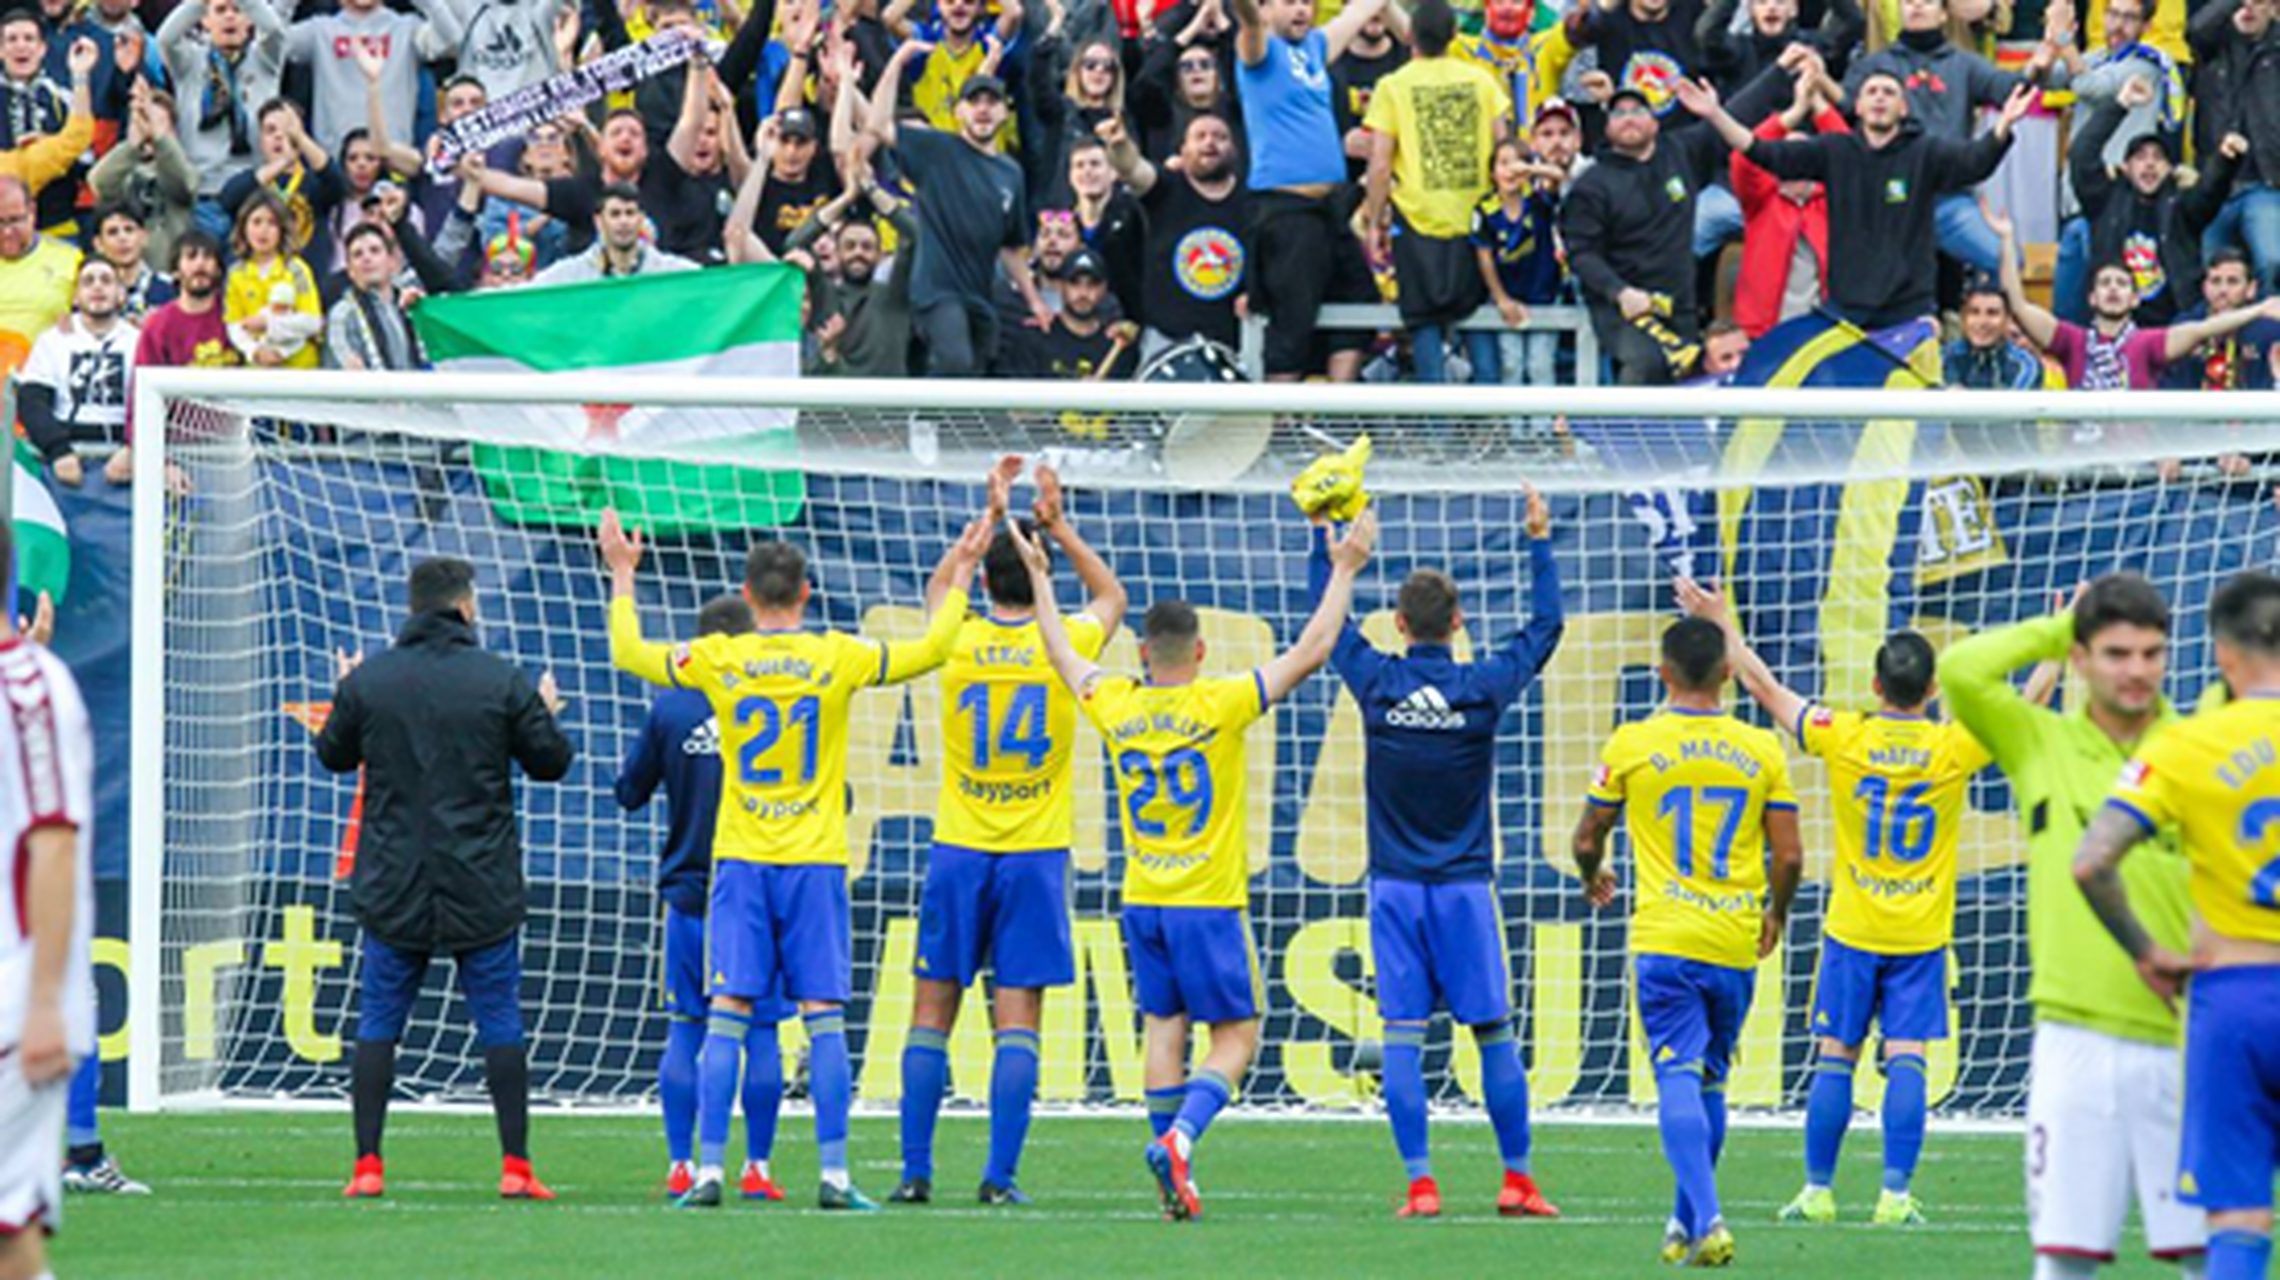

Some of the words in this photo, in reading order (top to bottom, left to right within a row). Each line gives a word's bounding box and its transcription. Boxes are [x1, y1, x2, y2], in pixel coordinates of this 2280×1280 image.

[733, 696, 820, 783] 21
[957, 682, 1052, 769] 14
[1386, 708, 1466, 729] adidas
[1119, 747, 1214, 838] 29
[1657, 786, 1748, 878] 17
[1855, 775, 1937, 862] 16
